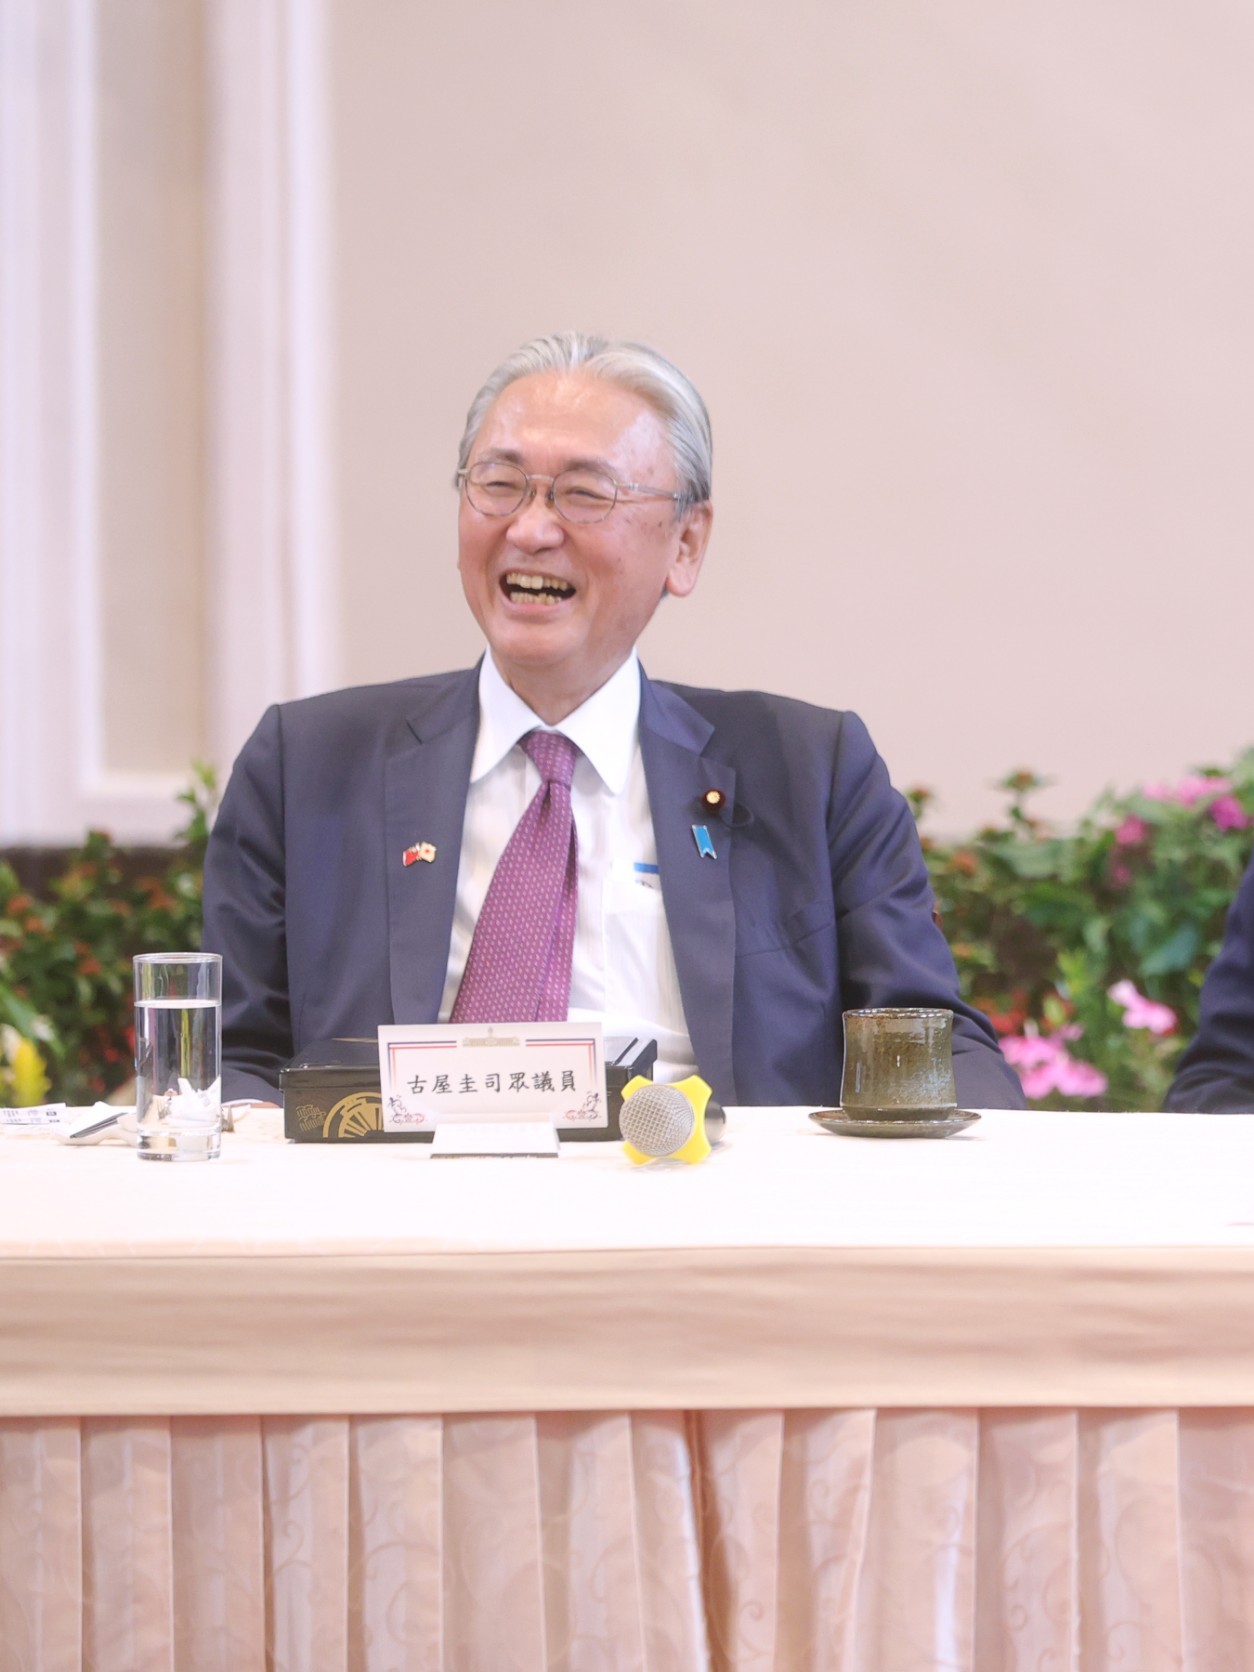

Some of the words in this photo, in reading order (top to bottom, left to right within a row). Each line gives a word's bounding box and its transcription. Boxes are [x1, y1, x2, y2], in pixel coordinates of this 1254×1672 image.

[406, 1069, 577, 1095] 古屋圭司眾議員
